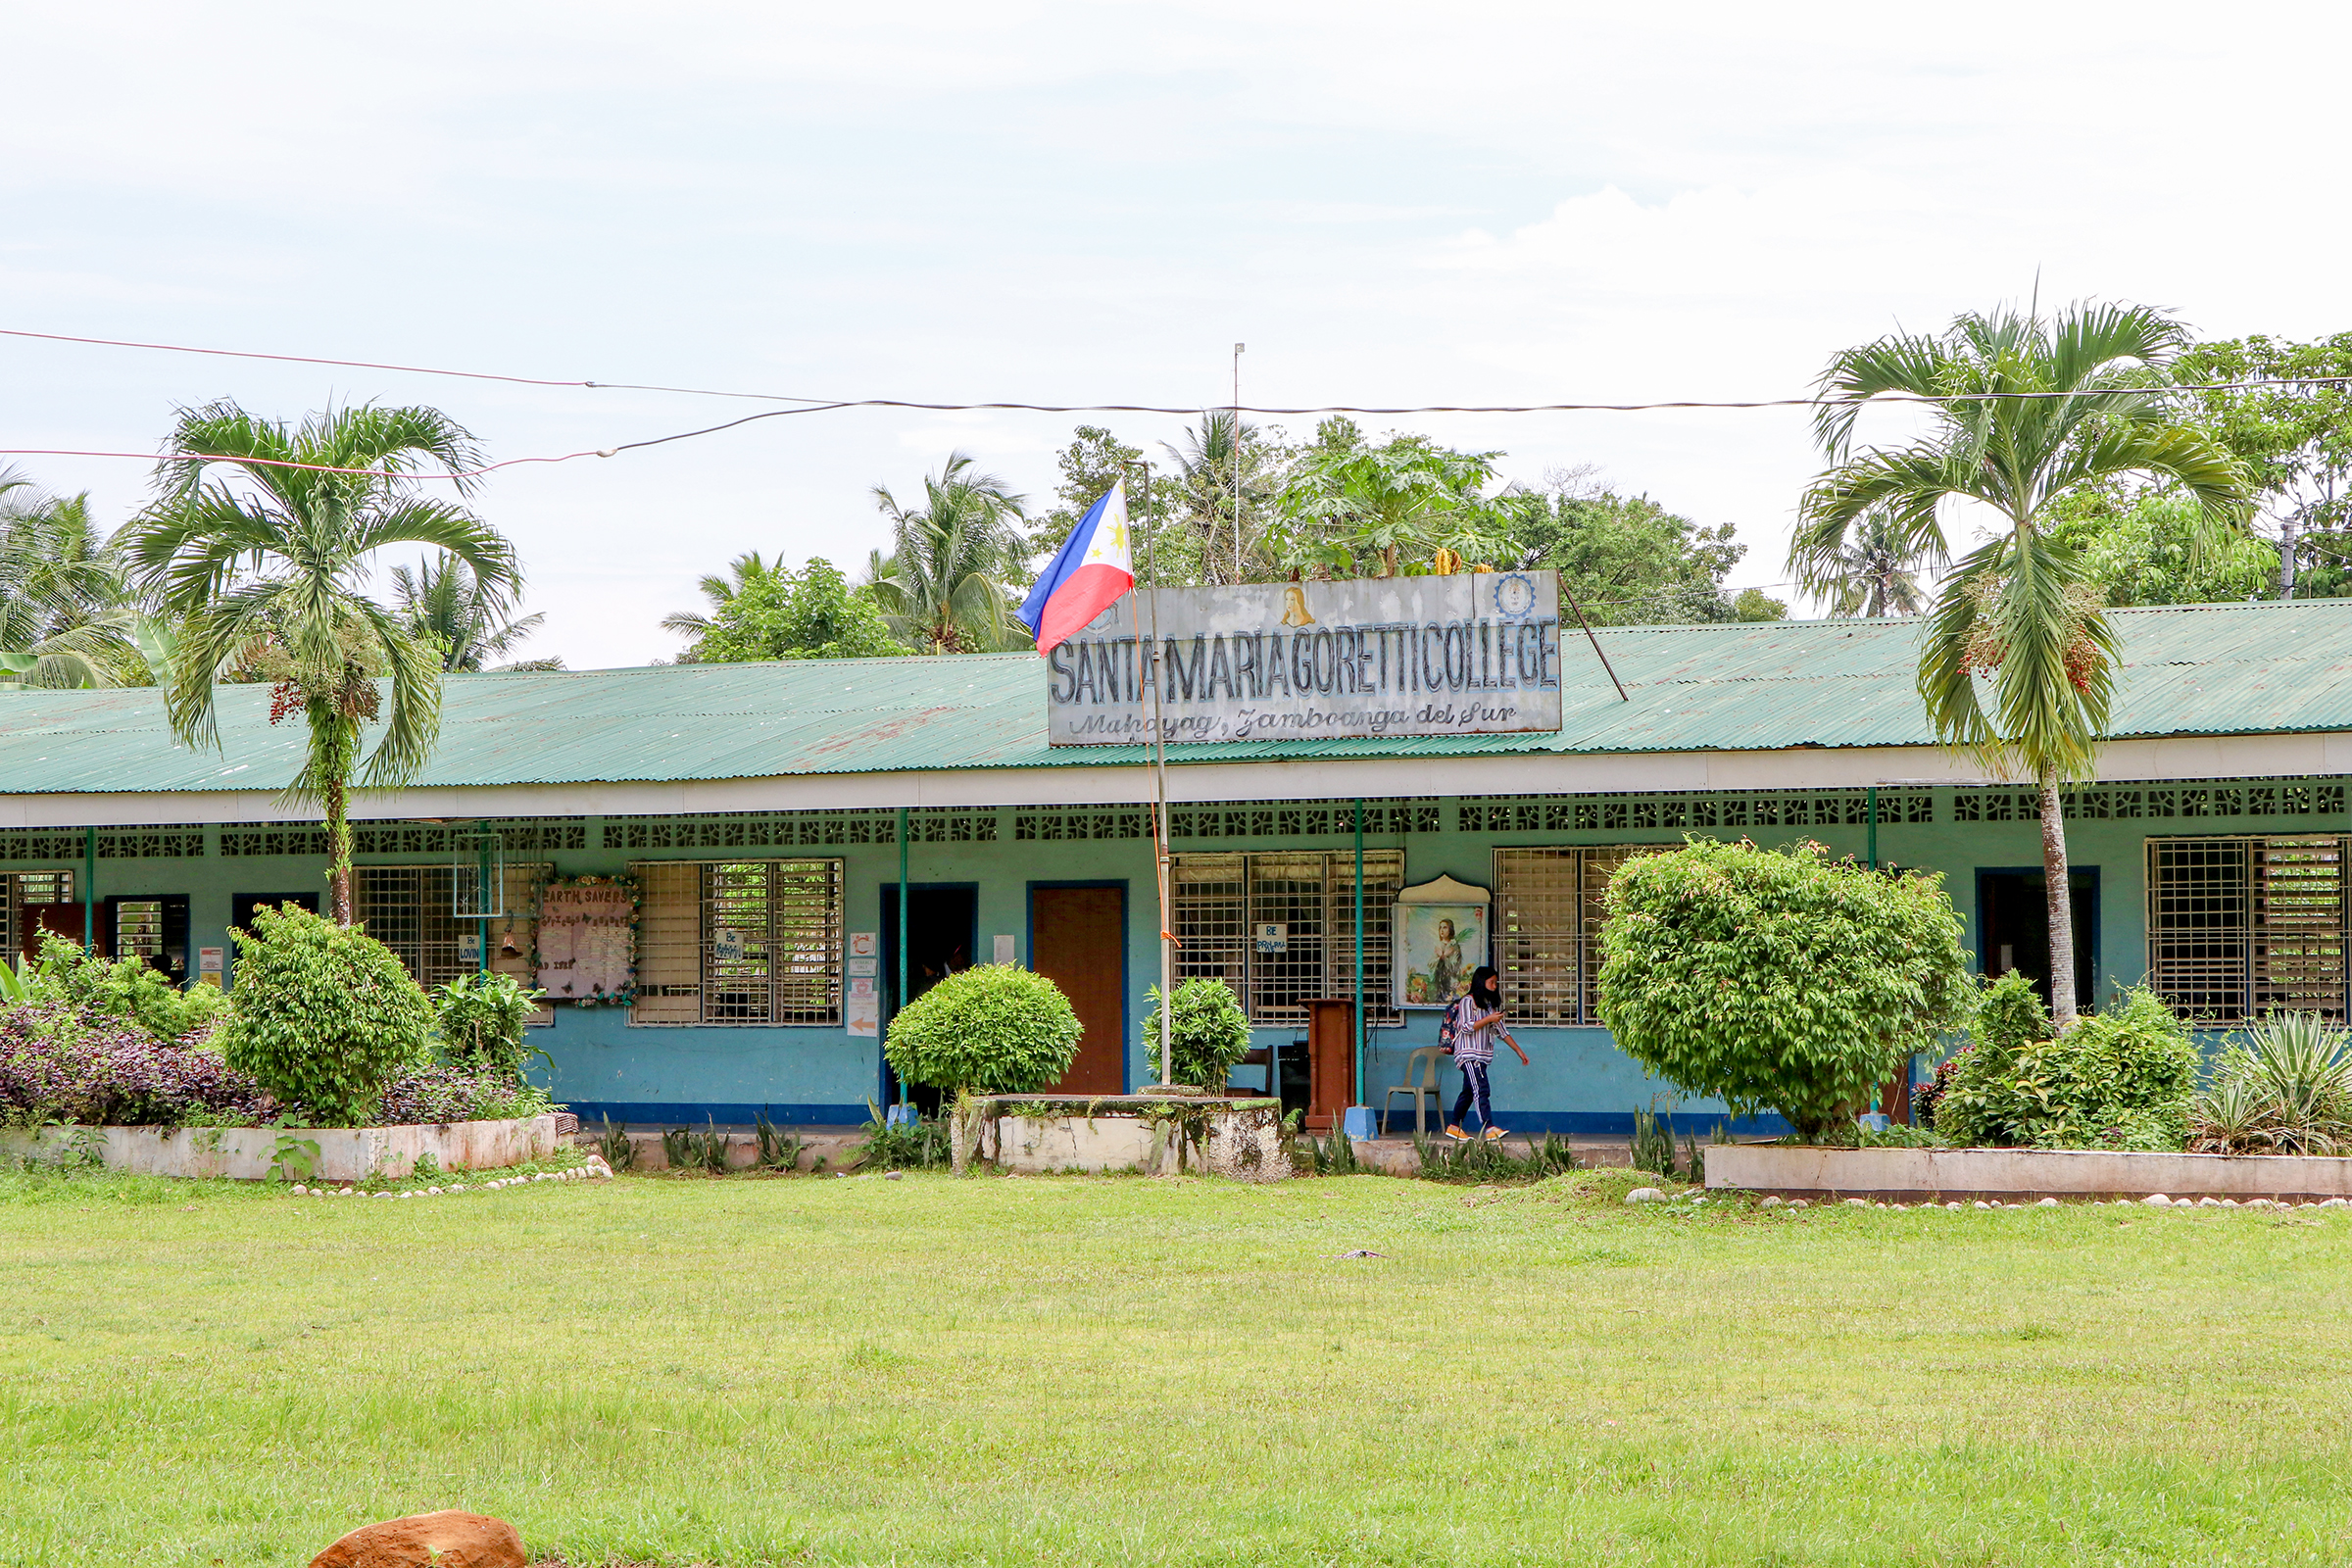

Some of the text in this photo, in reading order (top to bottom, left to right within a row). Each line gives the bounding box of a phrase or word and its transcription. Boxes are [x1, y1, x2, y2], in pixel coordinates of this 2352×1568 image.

[1051, 617, 1558, 705] SANTA MARIA GORETTI COLLEGE
[1236, 708, 1409, 737] Zamboanga
[1416, 704, 1454, 725] del
[1458, 702, 1517, 727] Sur
[543, 890, 627, 904] EARTH SAVERS
[1266, 925, 1277, 936] BE
[466, 936, 475, 945] Be
[726, 932, 736, 942] Be
[460, 948, 479, 959] LOVIN
